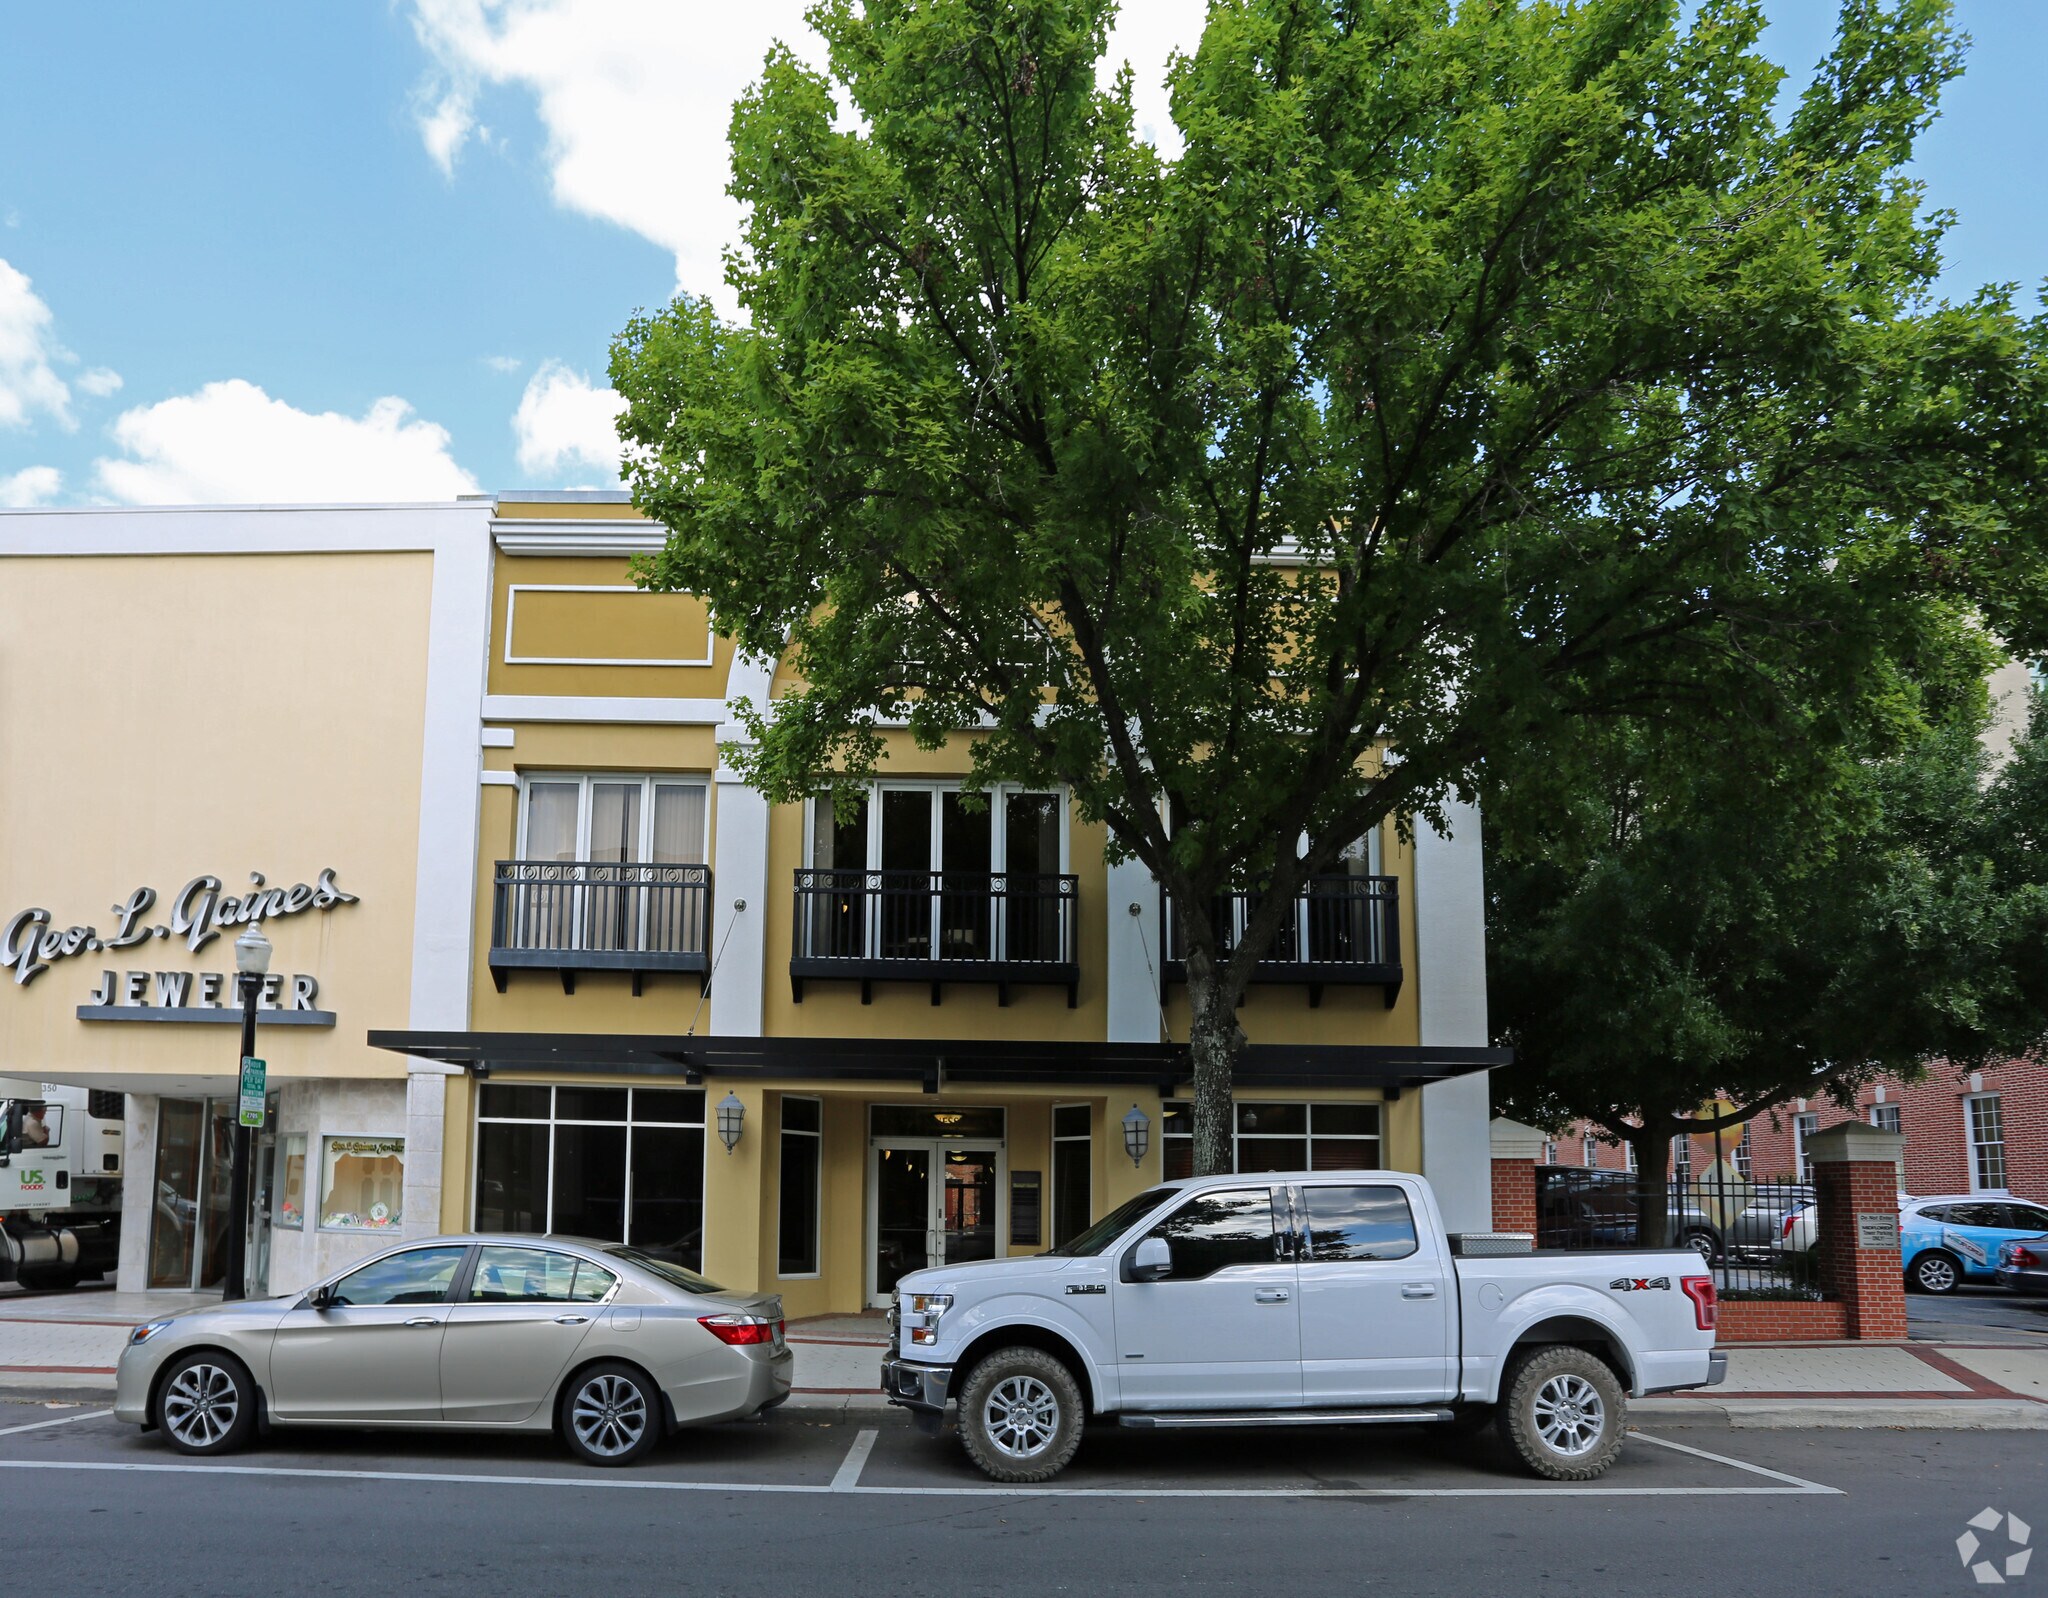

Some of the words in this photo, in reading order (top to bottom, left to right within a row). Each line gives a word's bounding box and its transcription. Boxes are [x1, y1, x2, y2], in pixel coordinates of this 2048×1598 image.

[0, 907, 104, 986] Geo.
[104, 887, 170, 950] L.
[171, 867, 360, 953] Gaines
